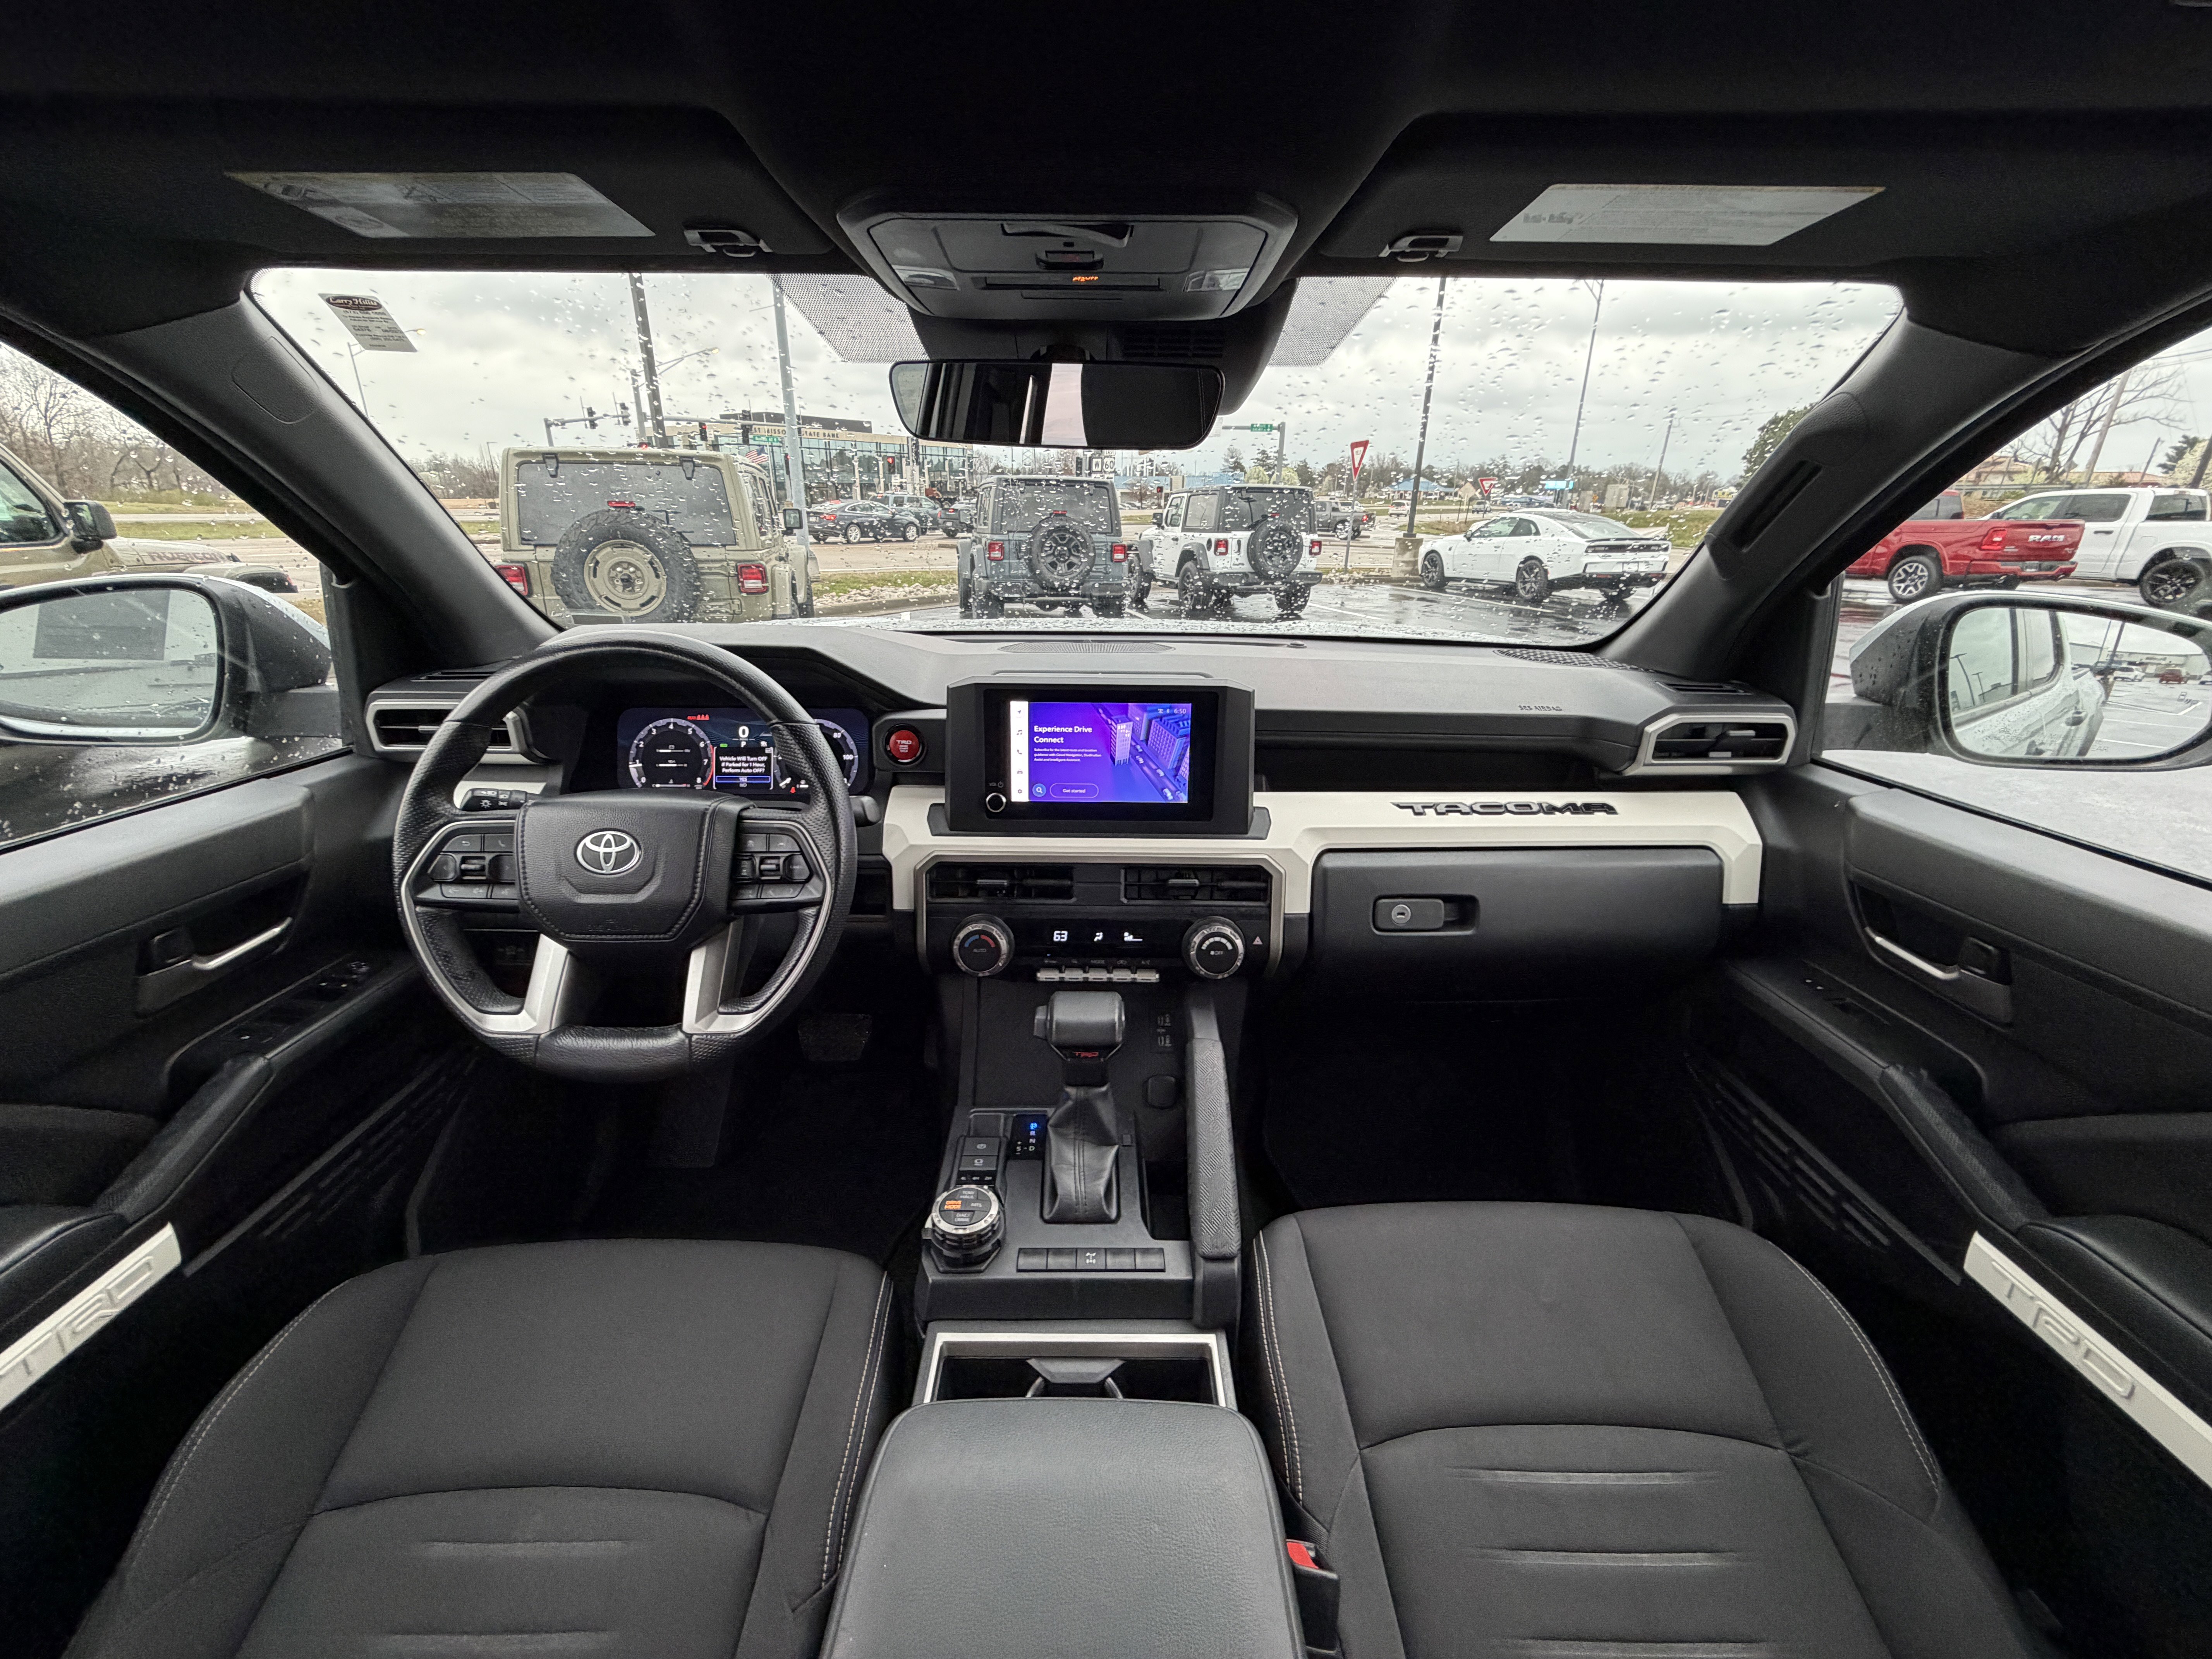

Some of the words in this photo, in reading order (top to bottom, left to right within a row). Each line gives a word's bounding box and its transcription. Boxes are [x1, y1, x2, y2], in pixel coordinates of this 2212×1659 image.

[1094, 460, 1100, 469] W
[1104, 460, 1114, 469] 60
[147, 551, 227, 562] RUBICON
[738, 726, 749, 738] 0
[1034, 725, 1072, 733] Experience
[1389, 802, 1619, 816] TACOMA
[1053, 931, 1068, 941] 63
[0, 1256, 154, 1377] TRD
[1991, 1261, 2136, 1400] TRD
